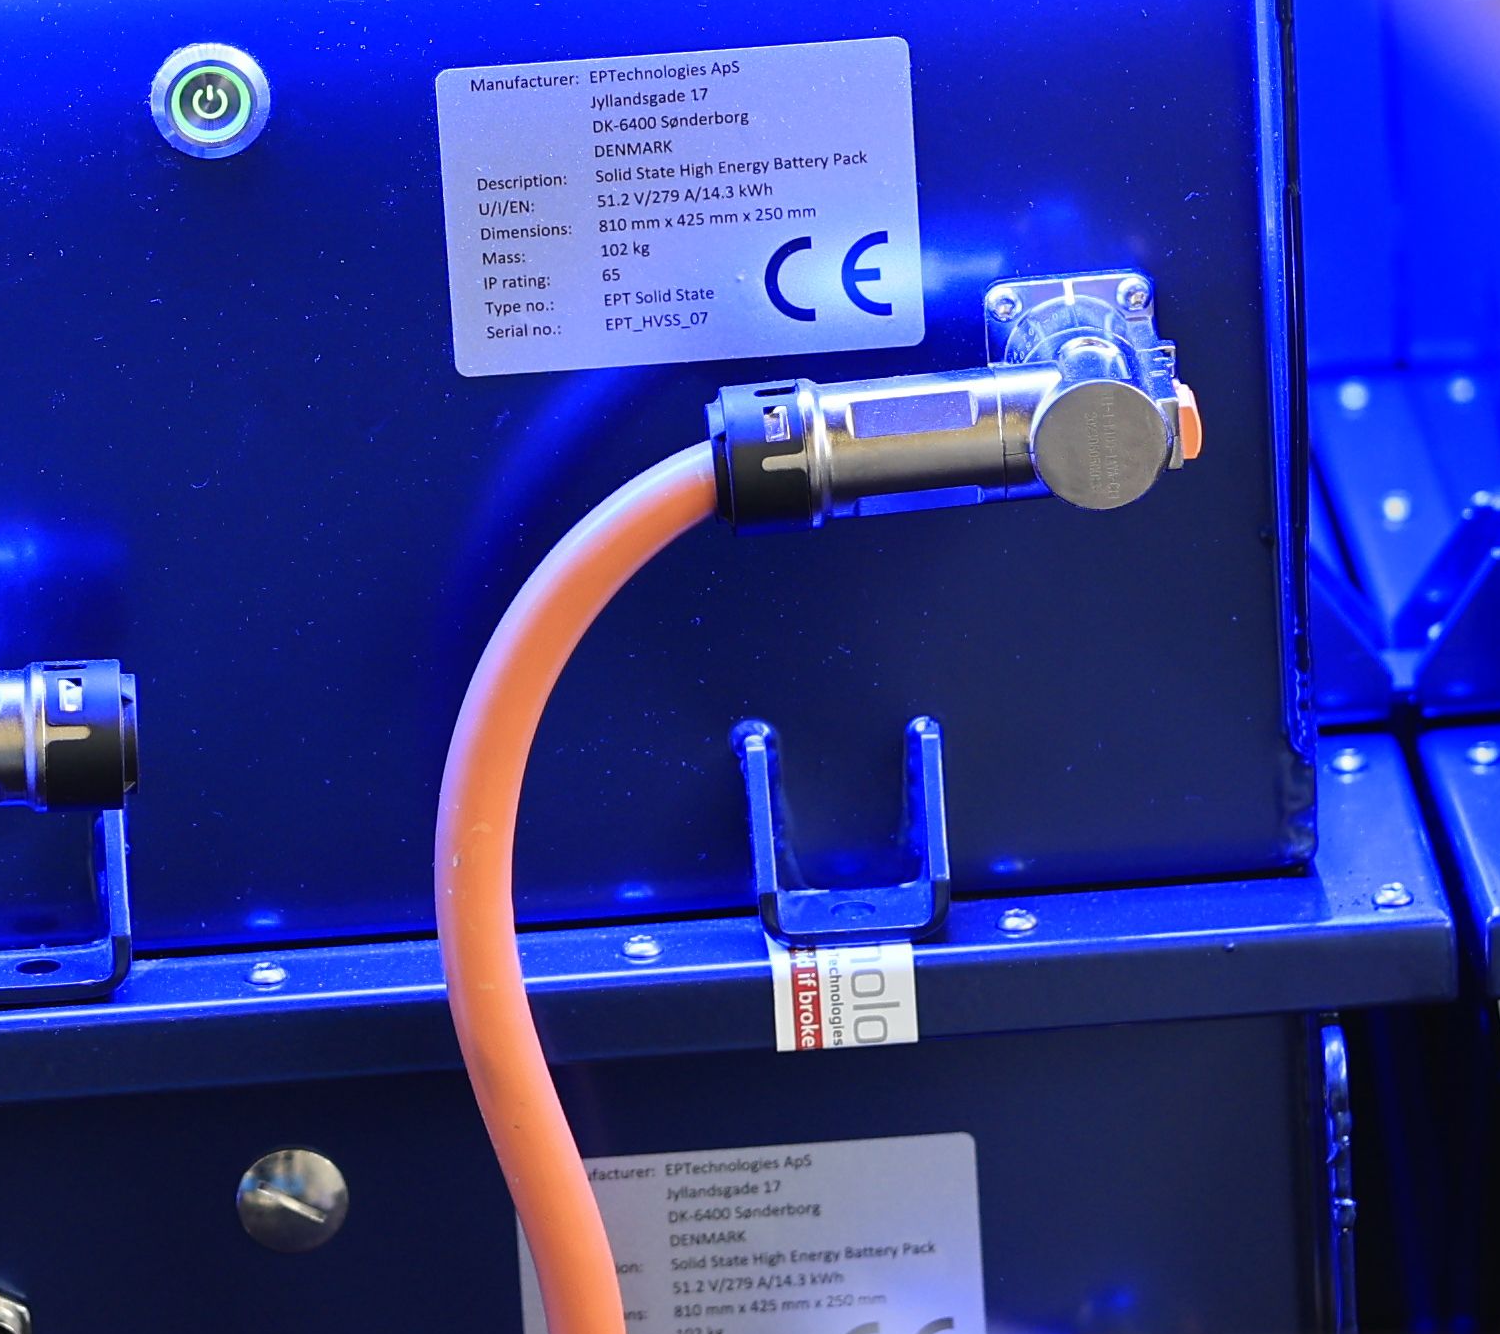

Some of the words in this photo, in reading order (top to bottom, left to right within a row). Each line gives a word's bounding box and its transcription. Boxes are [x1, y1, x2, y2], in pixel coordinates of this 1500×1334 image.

[471, 75, 579, 92] Manufacturer:
[589, 64, 707, 84] EPTechnologies
[711, 60, 740, 77] ApS
[590, 89, 686, 111] Jyllandsgade
[691, 87, 708, 102] 17
[593, 116, 657, 133] DK-6400
[661, 111, 749, 129] Sønderborg
[594, 140, 672, 158] DENMARK
[477, 174, 567, 191] Description:
[595, 167, 632, 183] Solid
[636, 167, 675, 180] State
[680, 162, 713, 179] High
[718, 161, 770, 175] Energy
[774, 157, 829, 170] Battery
[833, 150, 868, 166] Pack
[479, 199, 534, 218] U/I/EN:
[597, 193, 630, 208] 51.2
[633, 189, 680, 207] V/279
[684, 185, 734, 203] A/14.3
[739, 182, 773, 197] kWh
[480, 224, 572, 241] Dimensions:
[599, 218, 627, 233] 810
[631, 218, 660, 230] mm
[664, 218, 673, 228] x
[677, 212, 705, 226] 425
[709, 213, 738, 224] mm
[743, 212, 751, 222] x
[755, 207, 783, 221] 250
[787, 208, 816, 219] mm
[482, 251, 526, 265] Mass:
[601, 242, 628, 257] 102
[633, 241, 650, 257] kg
[483, 276, 497, 290] IP
[502, 274, 550, 290] rating:
[602, 268, 620, 282] 65
[484, 301, 521, 317] Type
[526, 301, 554, 312] no.:
[604, 292, 631, 307] EPT
[635, 289, 671, 305] Solid
[676, 288, 714, 302] State
[487, 323, 528, 339] Serial
[533, 325, 561, 336] no.:
[606, 311, 708, 331] EPT_HVSS_07
